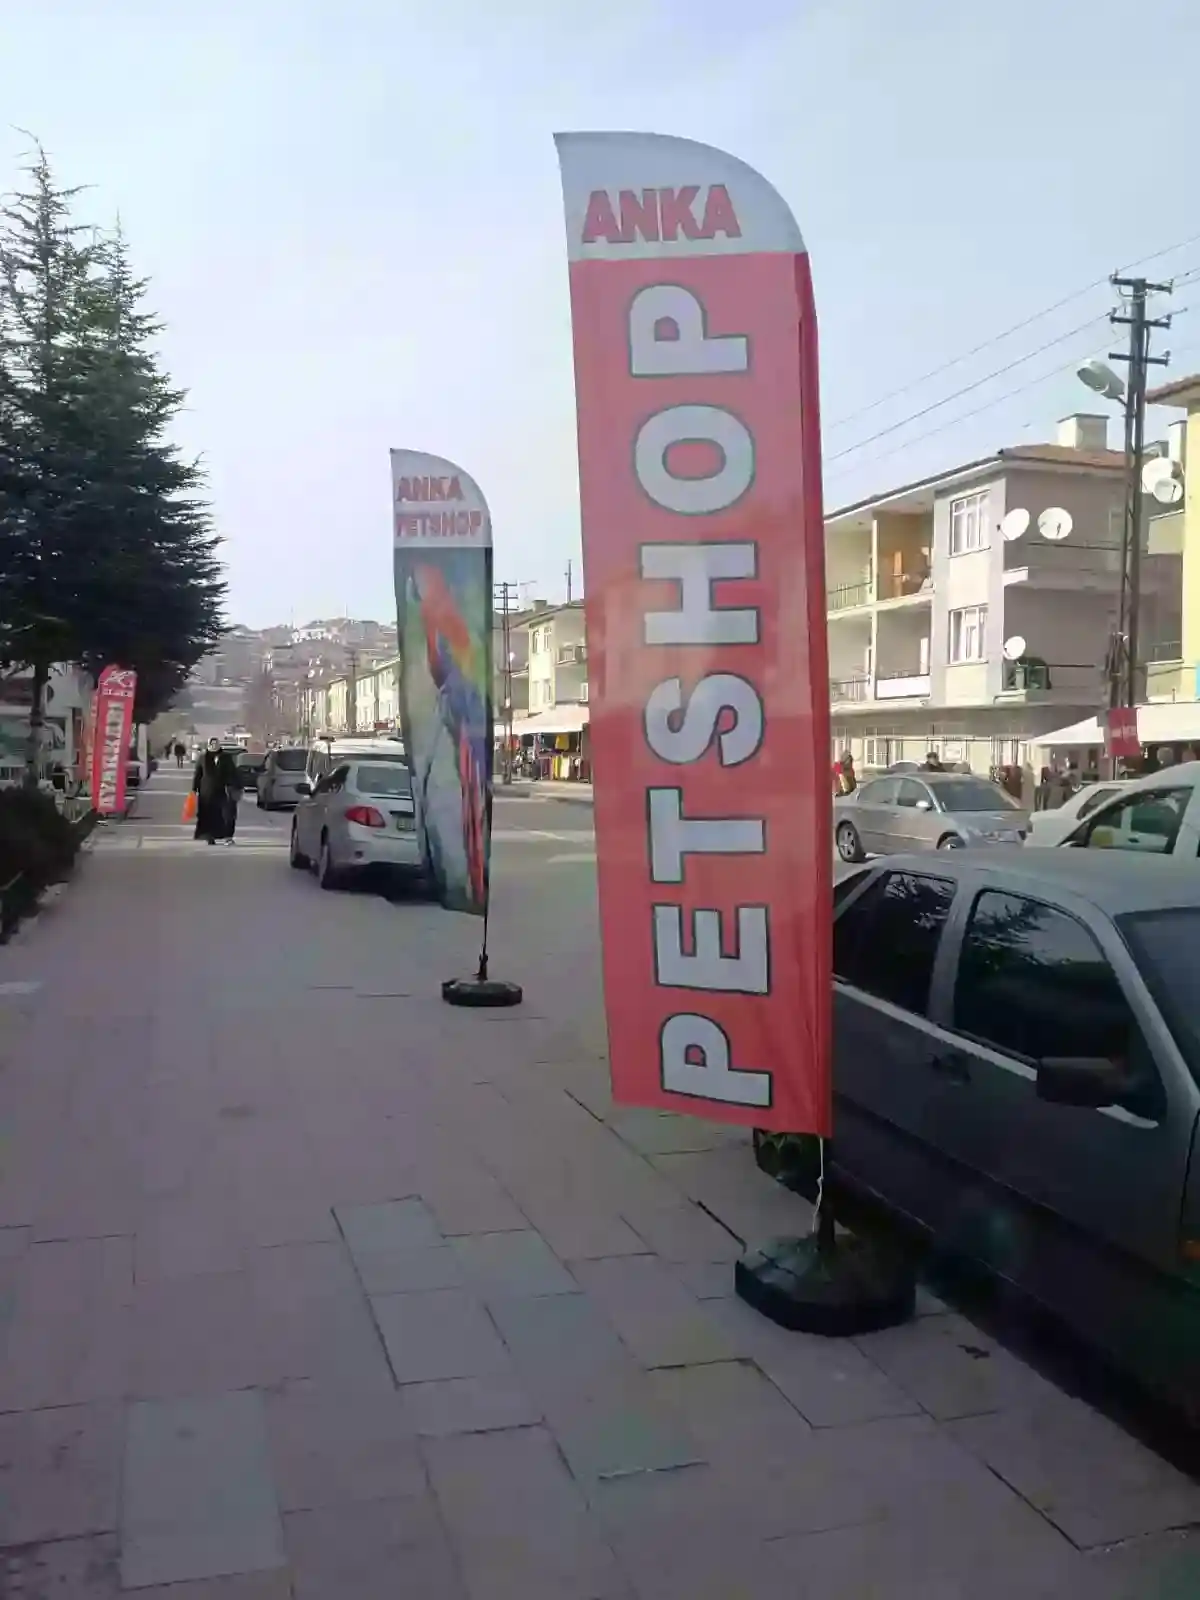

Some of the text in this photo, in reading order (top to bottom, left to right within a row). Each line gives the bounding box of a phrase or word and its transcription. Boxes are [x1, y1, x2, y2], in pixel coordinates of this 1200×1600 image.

[582, 183, 742, 244] ANKA
[397, 475, 465, 502] ANKA
[628, 282, 773, 1109] PETSHOP
